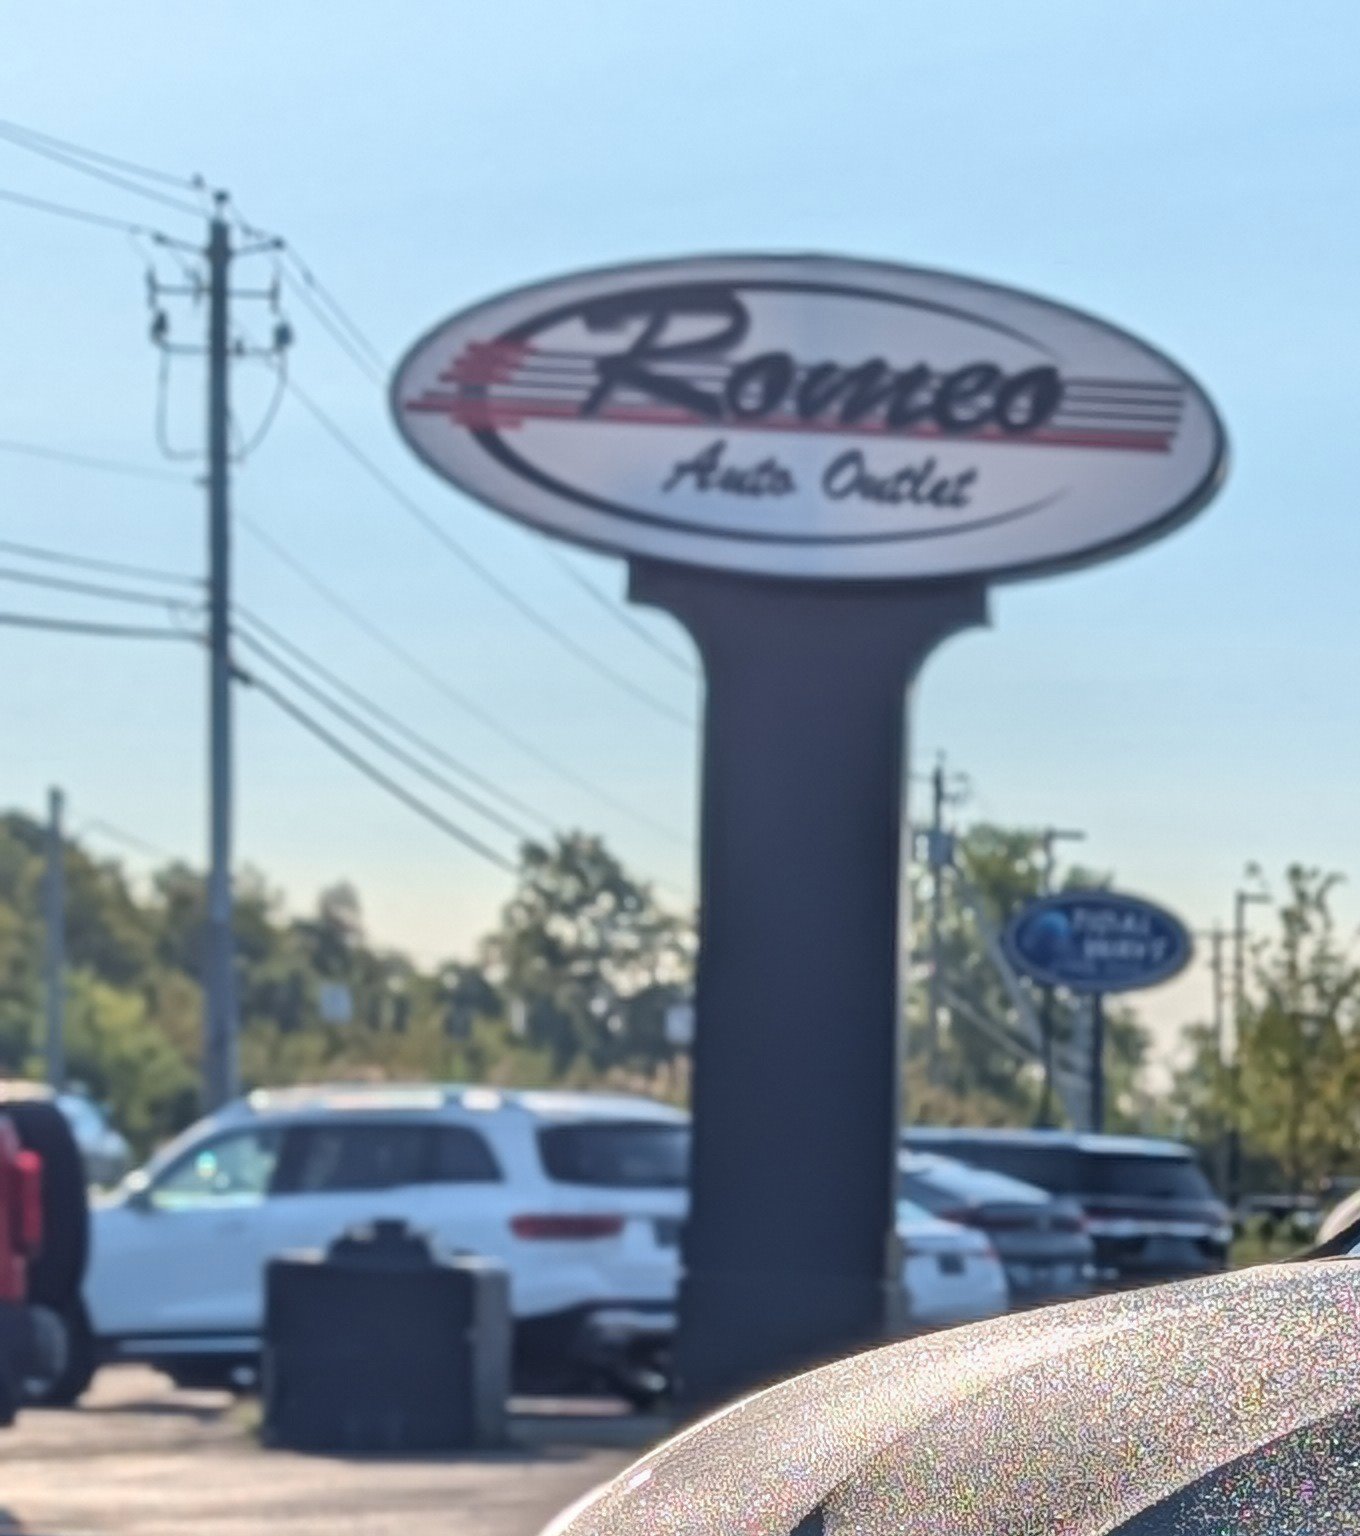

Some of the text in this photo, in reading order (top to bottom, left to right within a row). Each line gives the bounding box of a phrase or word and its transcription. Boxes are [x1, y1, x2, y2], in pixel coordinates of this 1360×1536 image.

[578, 286, 1066, 432] Romeo
[661, 439, 980, 510] Auto Outlet
